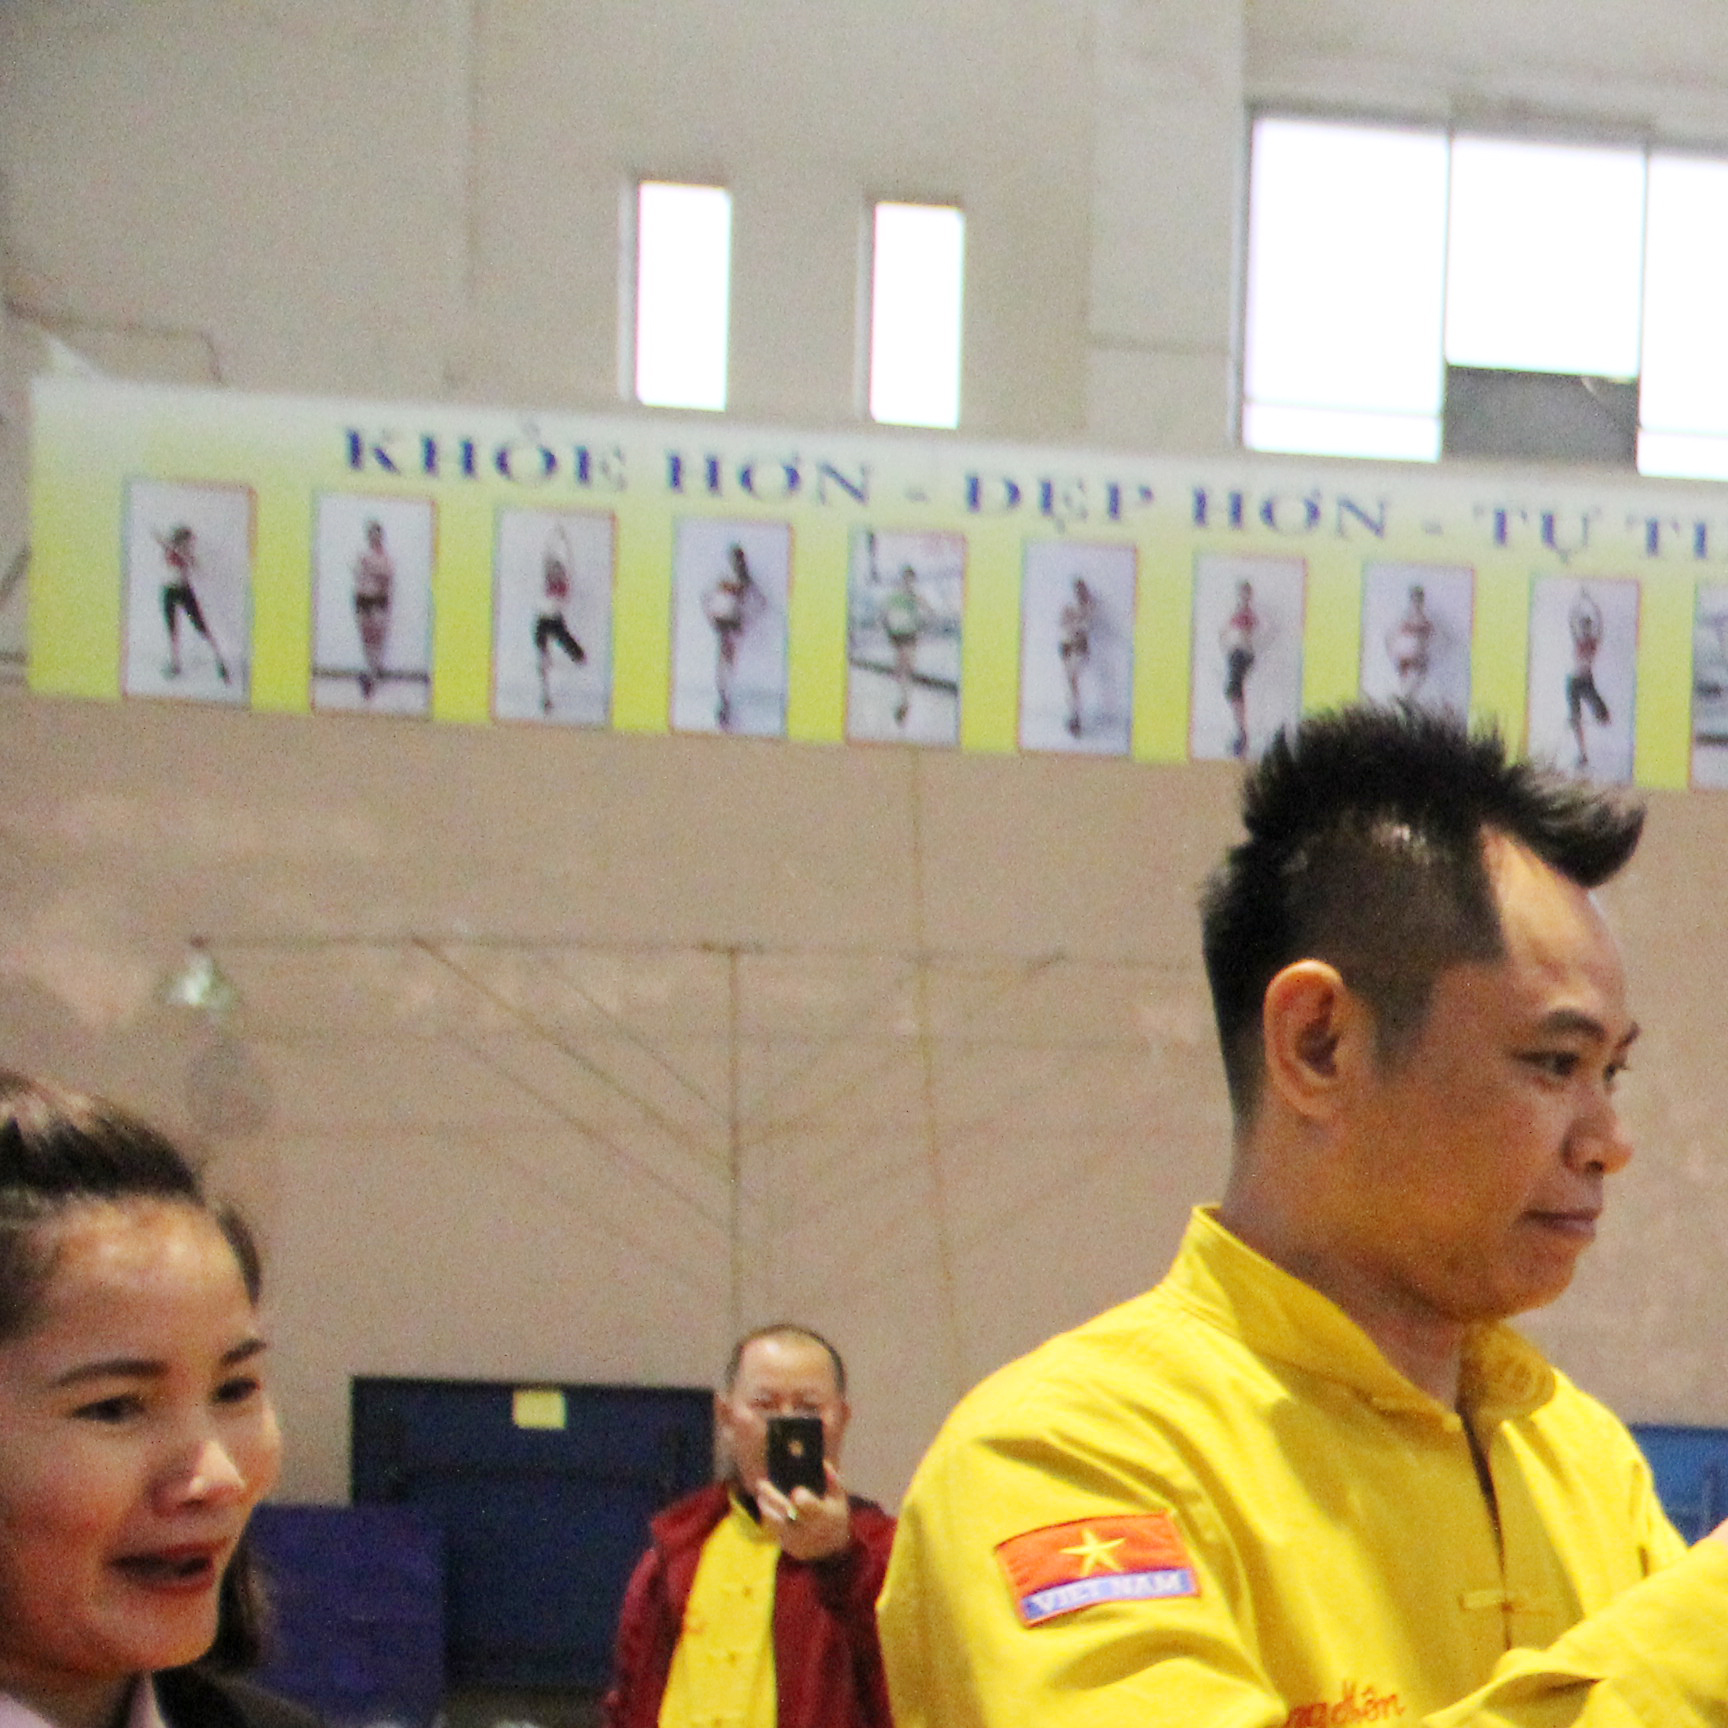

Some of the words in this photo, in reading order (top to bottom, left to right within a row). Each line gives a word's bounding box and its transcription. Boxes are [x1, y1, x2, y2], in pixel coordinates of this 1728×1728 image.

[345, 416, 627, 491] KHỎE
[667, 450, 873, 505] HƠN
[1191, 484, 1391, 538] HƠN
